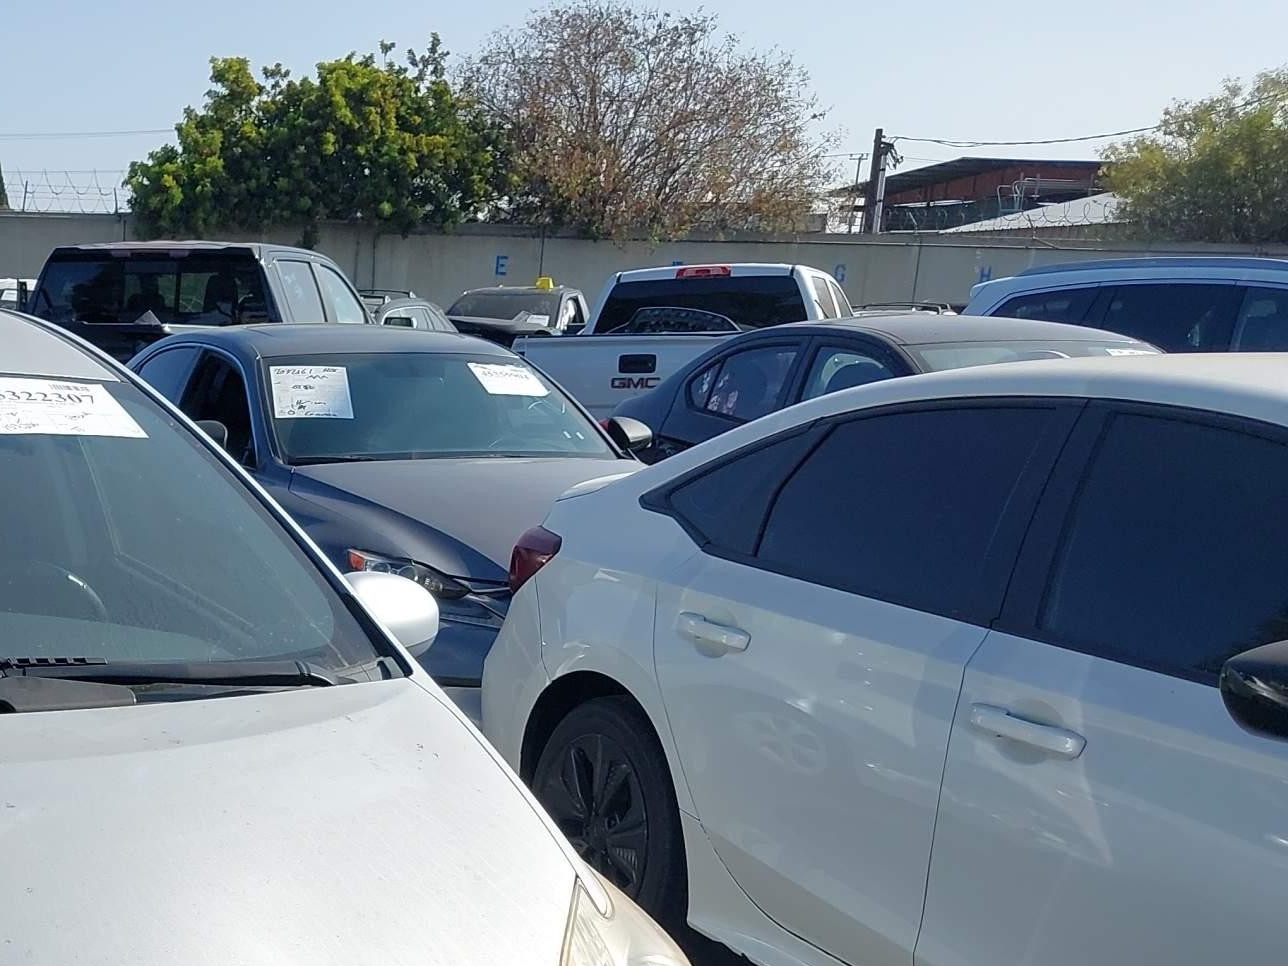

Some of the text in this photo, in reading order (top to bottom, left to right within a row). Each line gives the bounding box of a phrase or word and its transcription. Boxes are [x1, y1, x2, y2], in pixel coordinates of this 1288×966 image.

[494, 255, 509, 276] E
[834, 264, 847, 283] G
[979, 265, 993, 282] H
[610, 376, 661, 390] GMC
